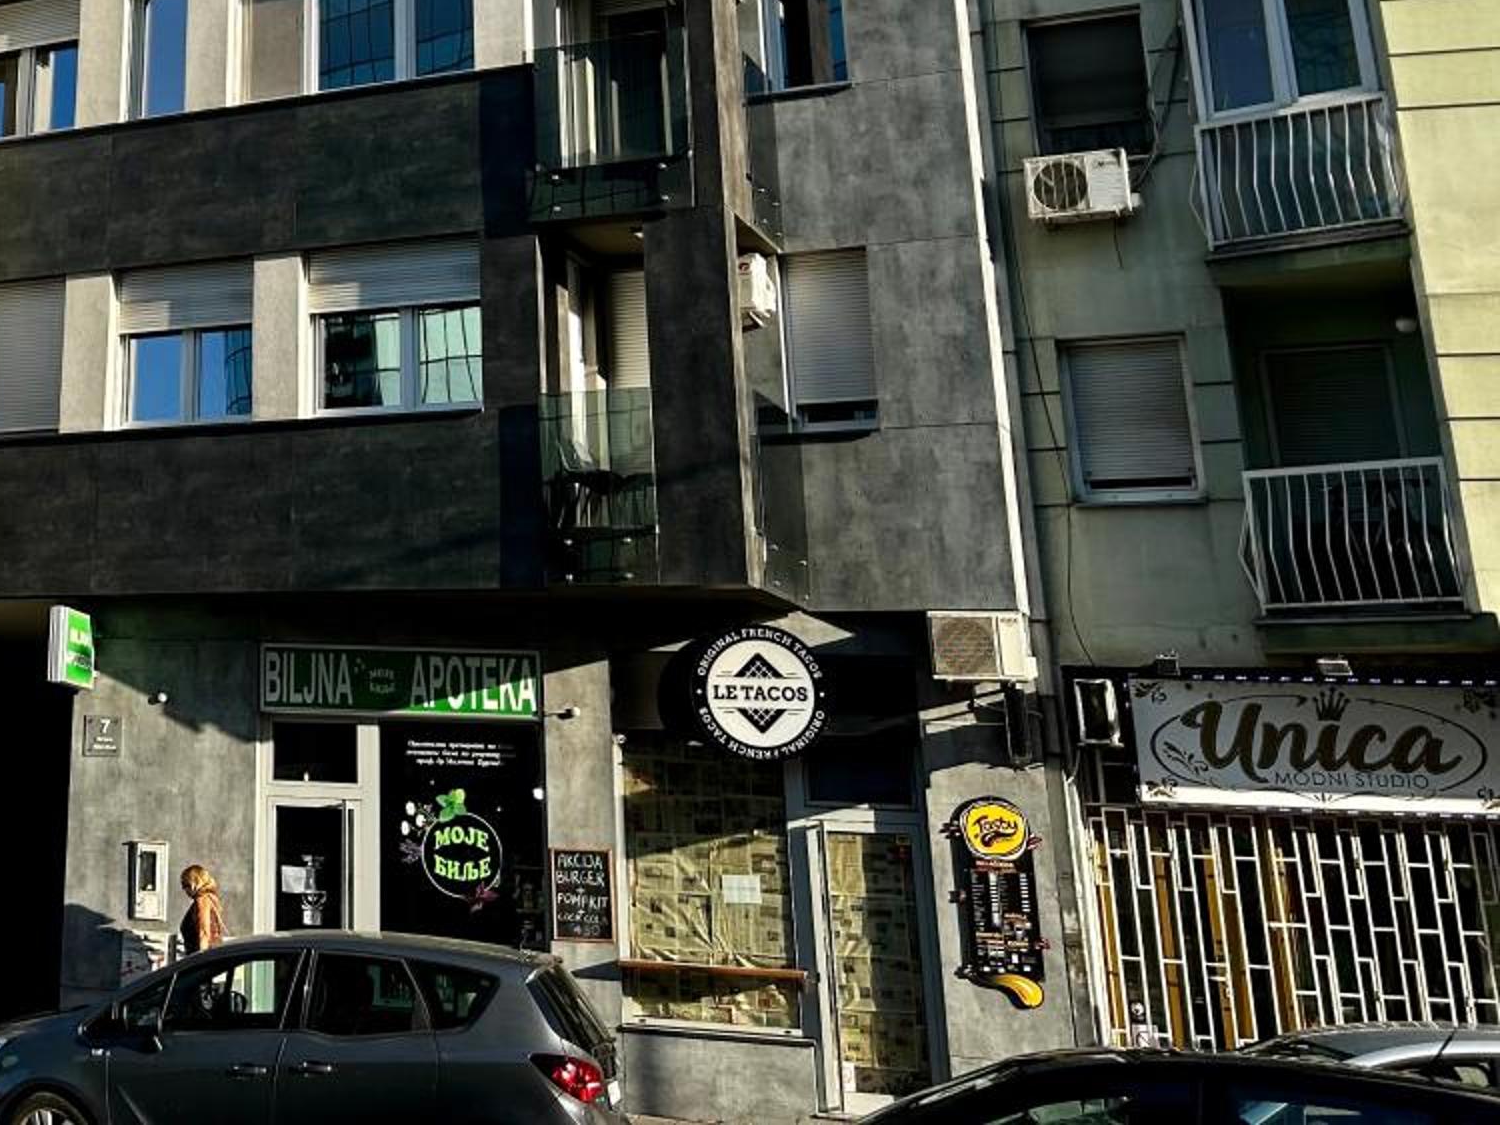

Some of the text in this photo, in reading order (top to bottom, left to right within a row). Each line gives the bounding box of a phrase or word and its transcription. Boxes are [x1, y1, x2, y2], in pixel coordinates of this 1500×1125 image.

[697, 628, 823, 679] ORIGINAL FRENCH TACOS
[264, 651, 538, 712] BILJNA APOTEKA
[713, 685, 808, 702] LE TACOS
[100, 718, 111, 734] 7
[1180, 701, 1463, 784] Unica
[1273, 771, 1430, 790] MODNI STUDIO
[434, 826, 489, 851] МОЈЕ
[434, 854, 491, 882] БИЉЕ
[556, 871, 605, 887] BURGER
